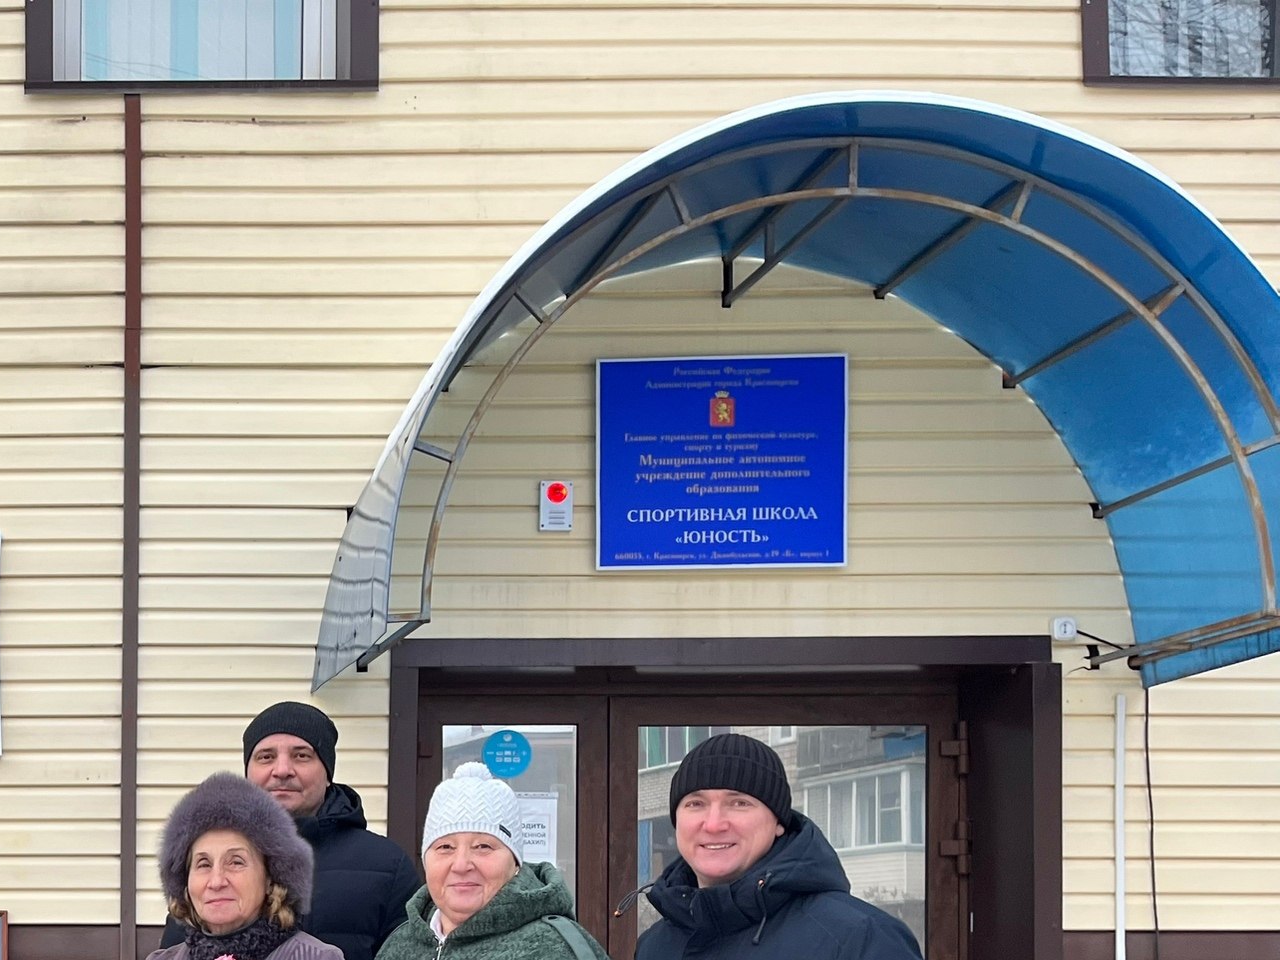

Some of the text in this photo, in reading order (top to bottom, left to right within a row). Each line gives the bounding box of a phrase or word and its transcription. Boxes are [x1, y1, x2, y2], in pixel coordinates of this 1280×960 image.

[639, 453, 806, 468] Муниципальное автономное
[634, 468, 810, 483] учреждение дополнительного
[685, 483, 759, 496] образования
[627, 507, 818, 523] СПОРТИВНАЯ ШКОЛА
[675, 529, 769, 544] «ЮНОСТЬ»
